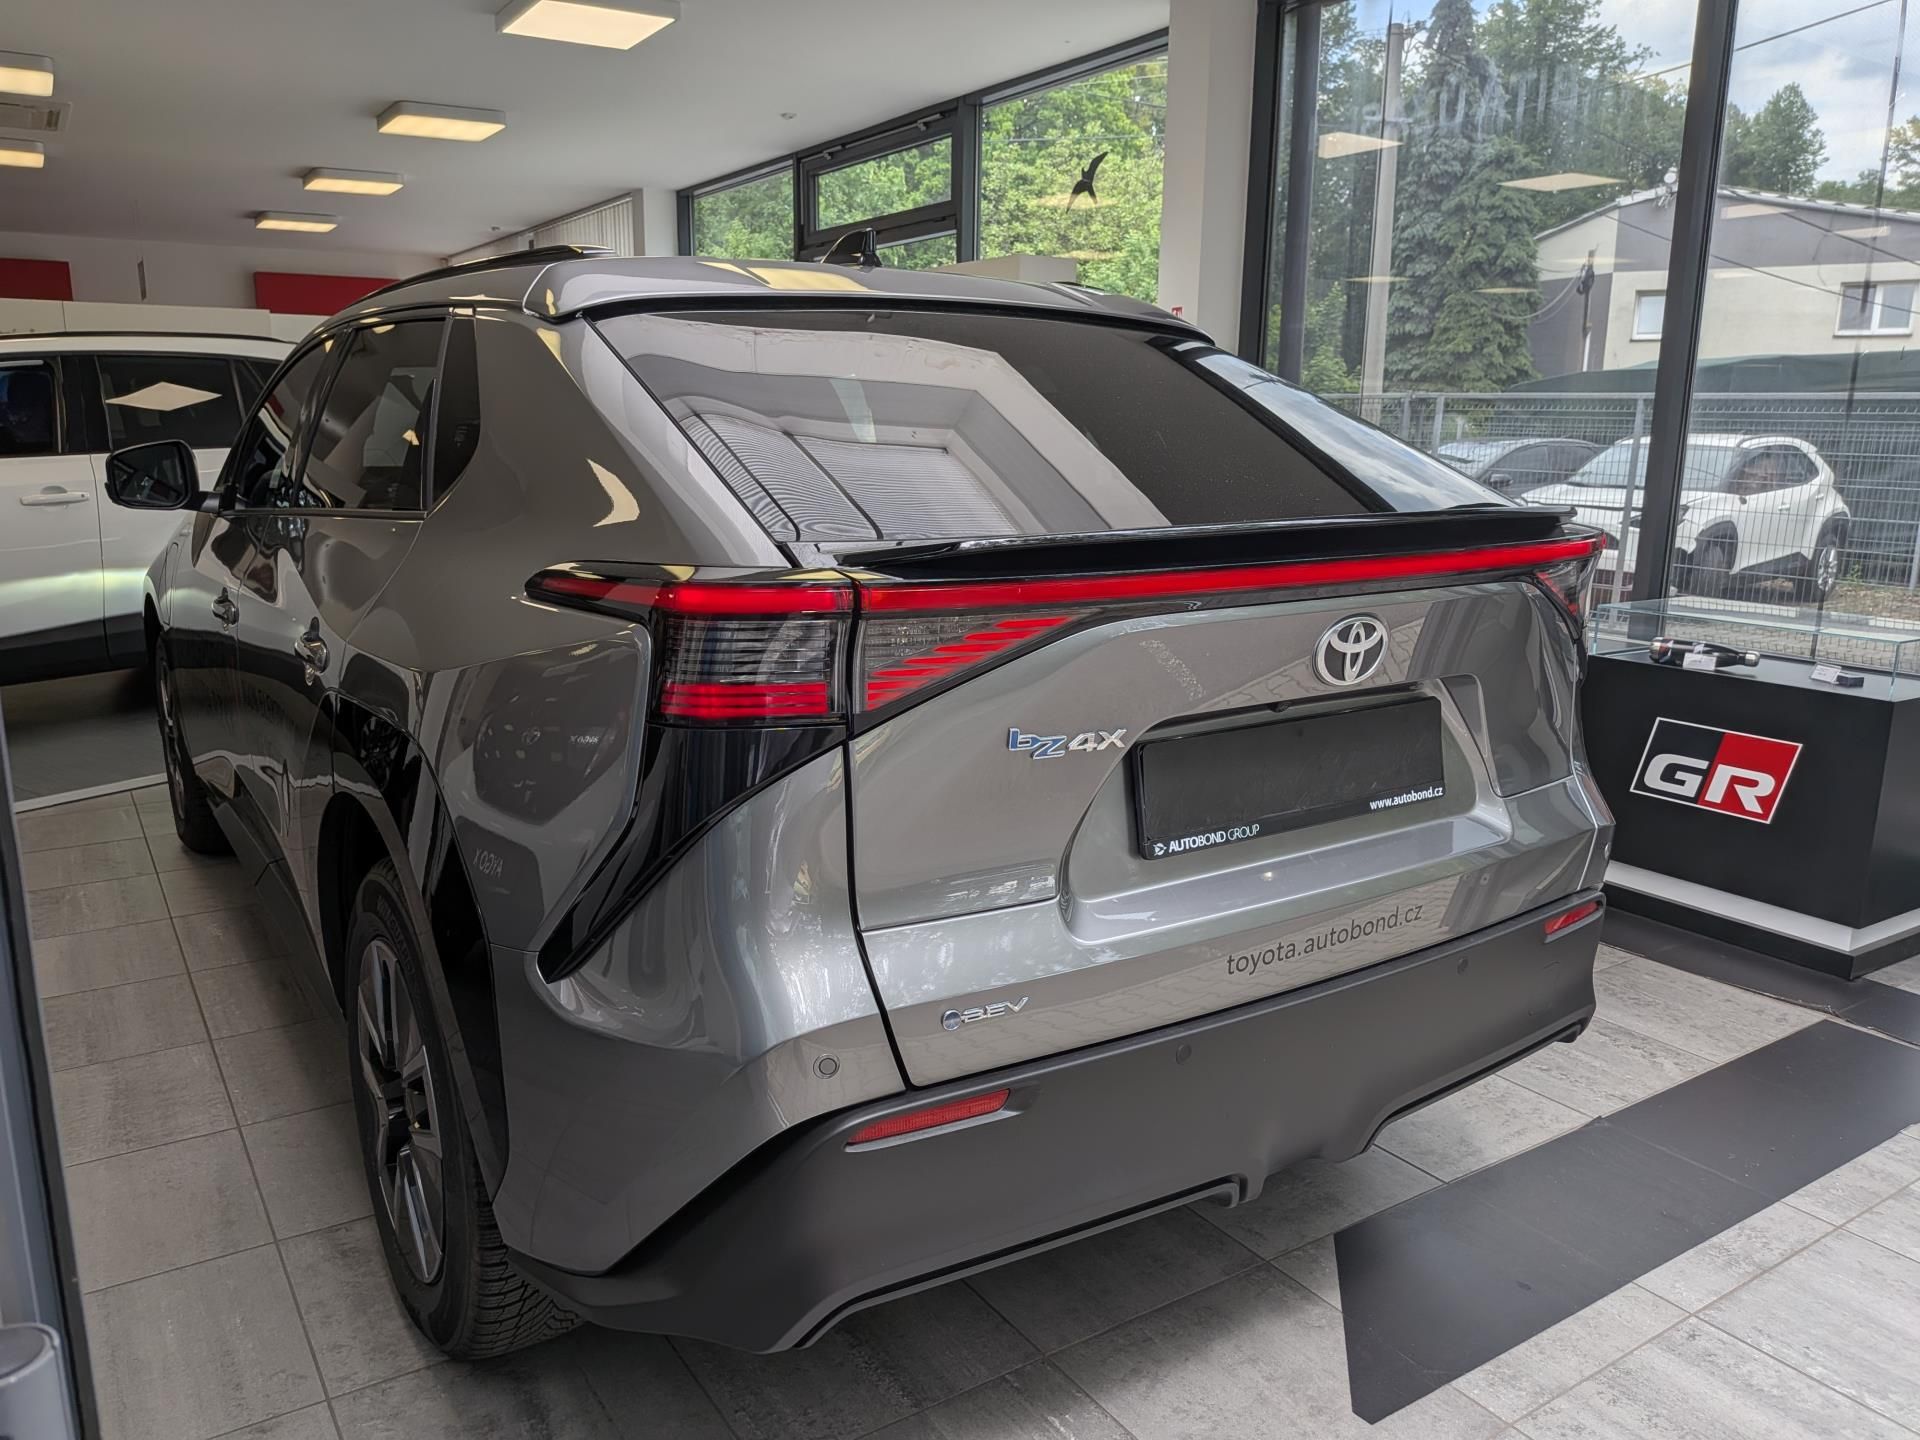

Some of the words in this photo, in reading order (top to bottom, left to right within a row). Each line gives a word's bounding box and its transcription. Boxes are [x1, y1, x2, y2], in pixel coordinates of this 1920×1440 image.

[1369, 786, 1443, 810] www.autobond.cz
[1644, 754, 1776, 814] GR
[1168, 831, 1227, 853] AUTOBOND
[1227, 823, 1260, 841] GROUP
[1226, 904, 1424, 976] toyota.autobond.cz
[961, 996, 1029, 1023] BEV
